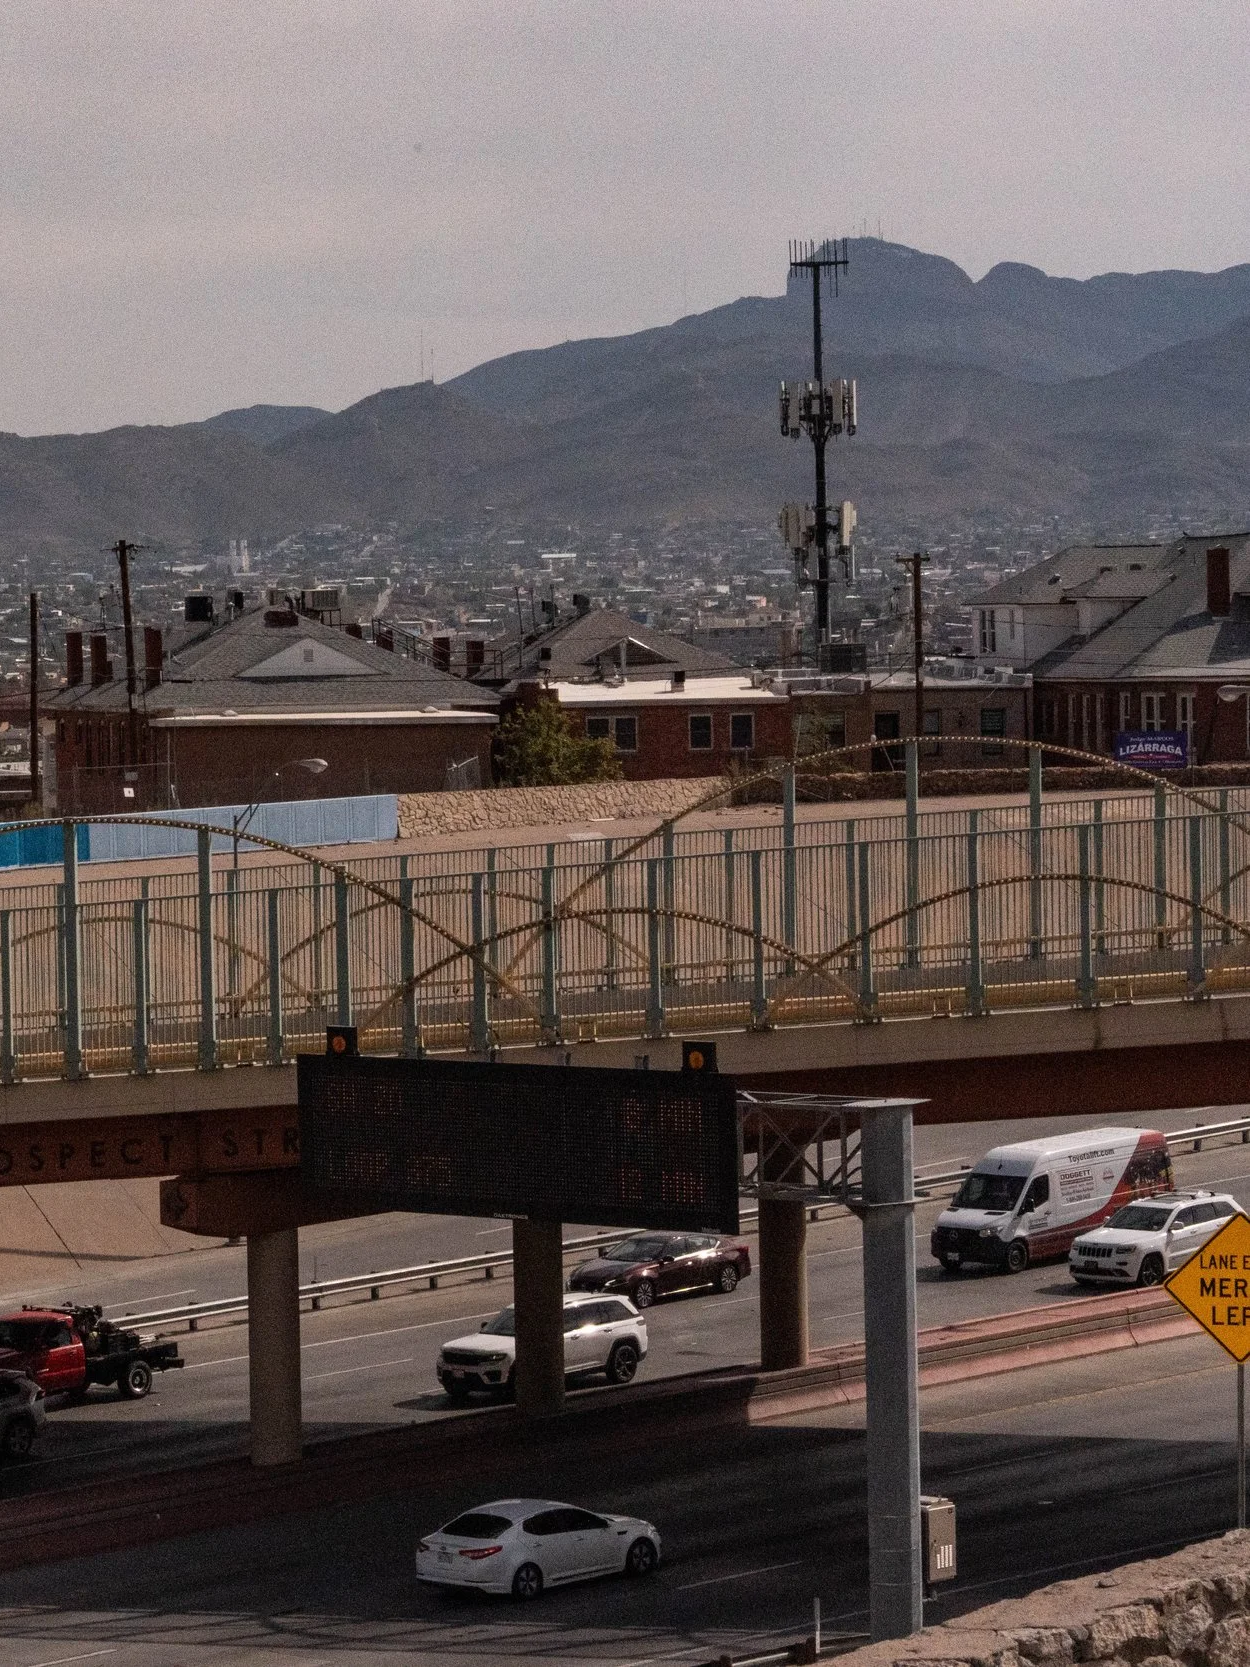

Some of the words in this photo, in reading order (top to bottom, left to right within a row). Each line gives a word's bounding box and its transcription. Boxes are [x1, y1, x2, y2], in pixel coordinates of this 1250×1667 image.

[1119, 742, 1183, 756] LIZÁRRAGA
[660, 1099, 702, 1132] MIN
[1060, 1169, 1091, 1180] DOGGETT
[662, 1170, 704, 1203] MIN
[1200, 1255, 1238, 1270] LANE
[1200, 1278, 1248, 1298] MER
